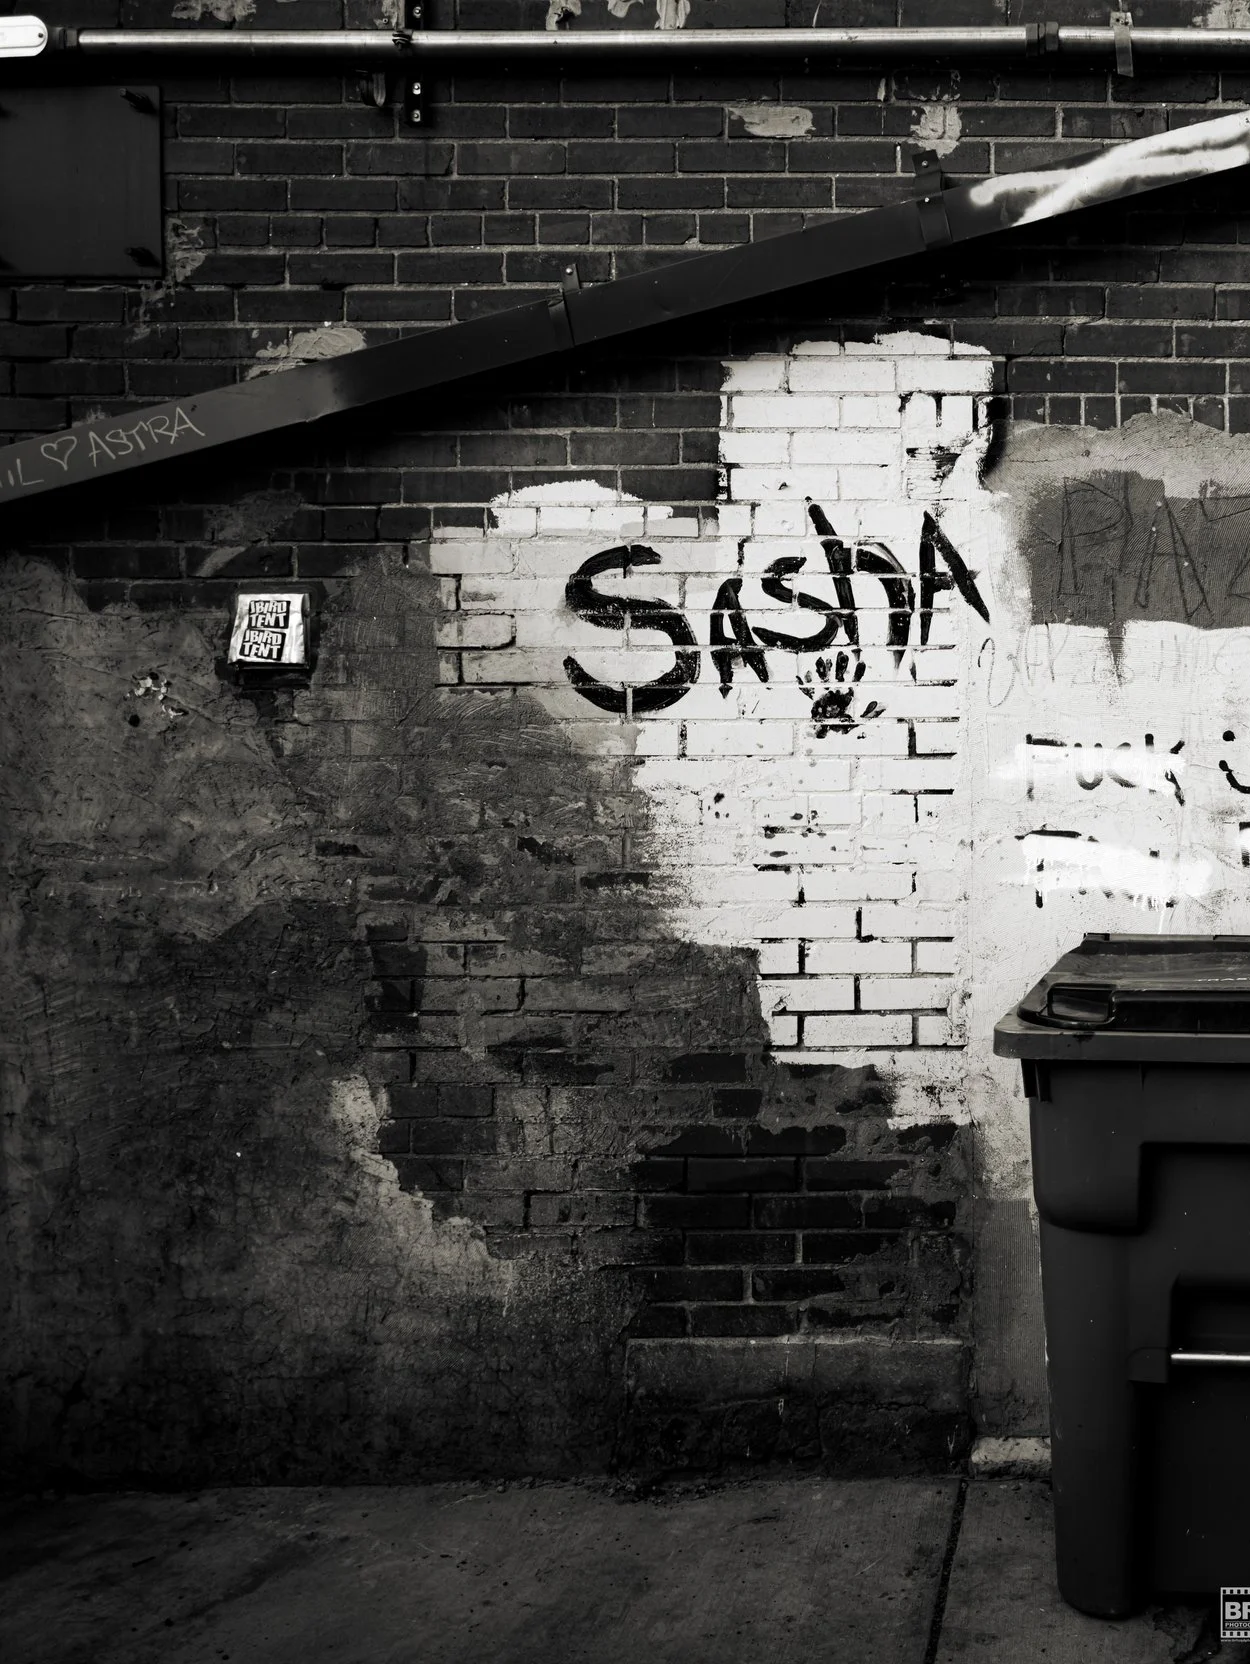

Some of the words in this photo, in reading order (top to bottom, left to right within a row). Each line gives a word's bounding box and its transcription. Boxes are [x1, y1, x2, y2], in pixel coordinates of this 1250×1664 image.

[88, 406, 206, 468] ASTRA
[249, 612, 288, 628] TENT
[242, 642, 281, 659] TENT
